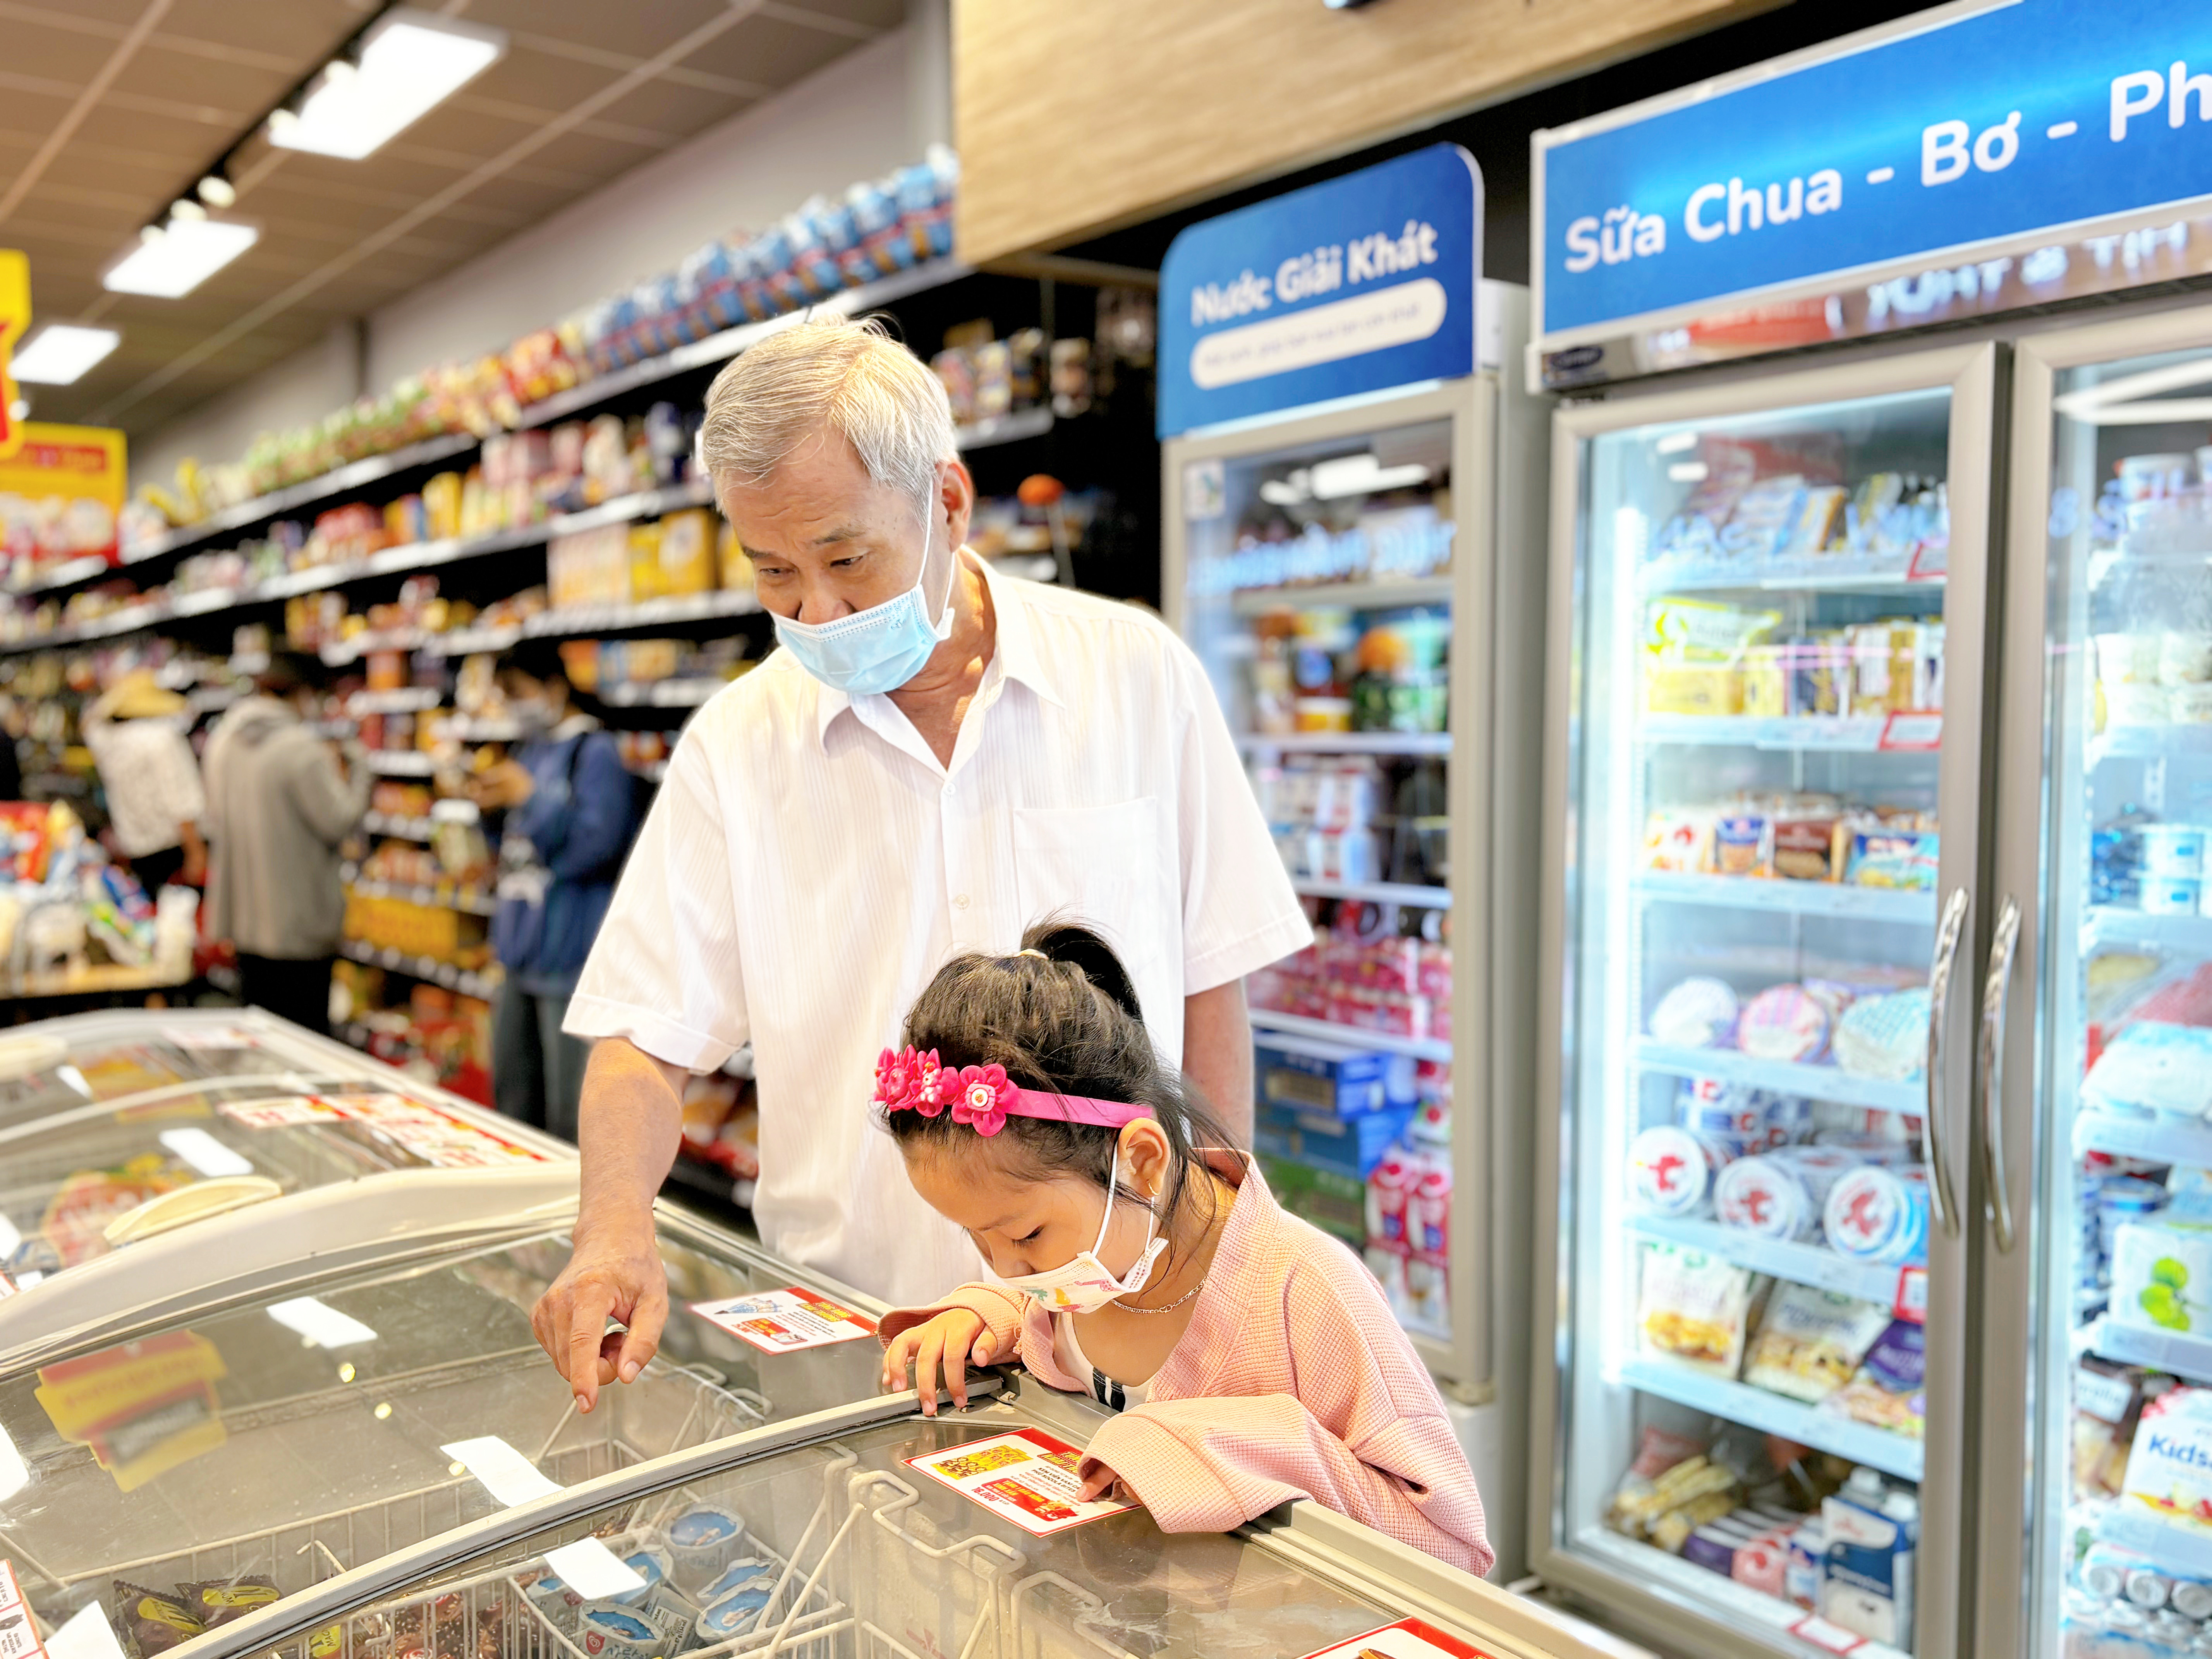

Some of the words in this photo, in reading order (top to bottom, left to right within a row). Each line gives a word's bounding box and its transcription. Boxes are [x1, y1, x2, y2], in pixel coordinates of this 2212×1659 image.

[1564, 204, 1666, 273] Sữa
[1684, 177, 1842, 243] Chua
[1920, 110, 2022, 189] Bơ
[2109, 60, 2212, 143] Ph
[1190, 267, 1272, 328] Nước
[1276, 244, 1343, 304] Giải
[1348, 220, 1439, 285] Khát
[2150, 1434, 2212, 1470] Kids
